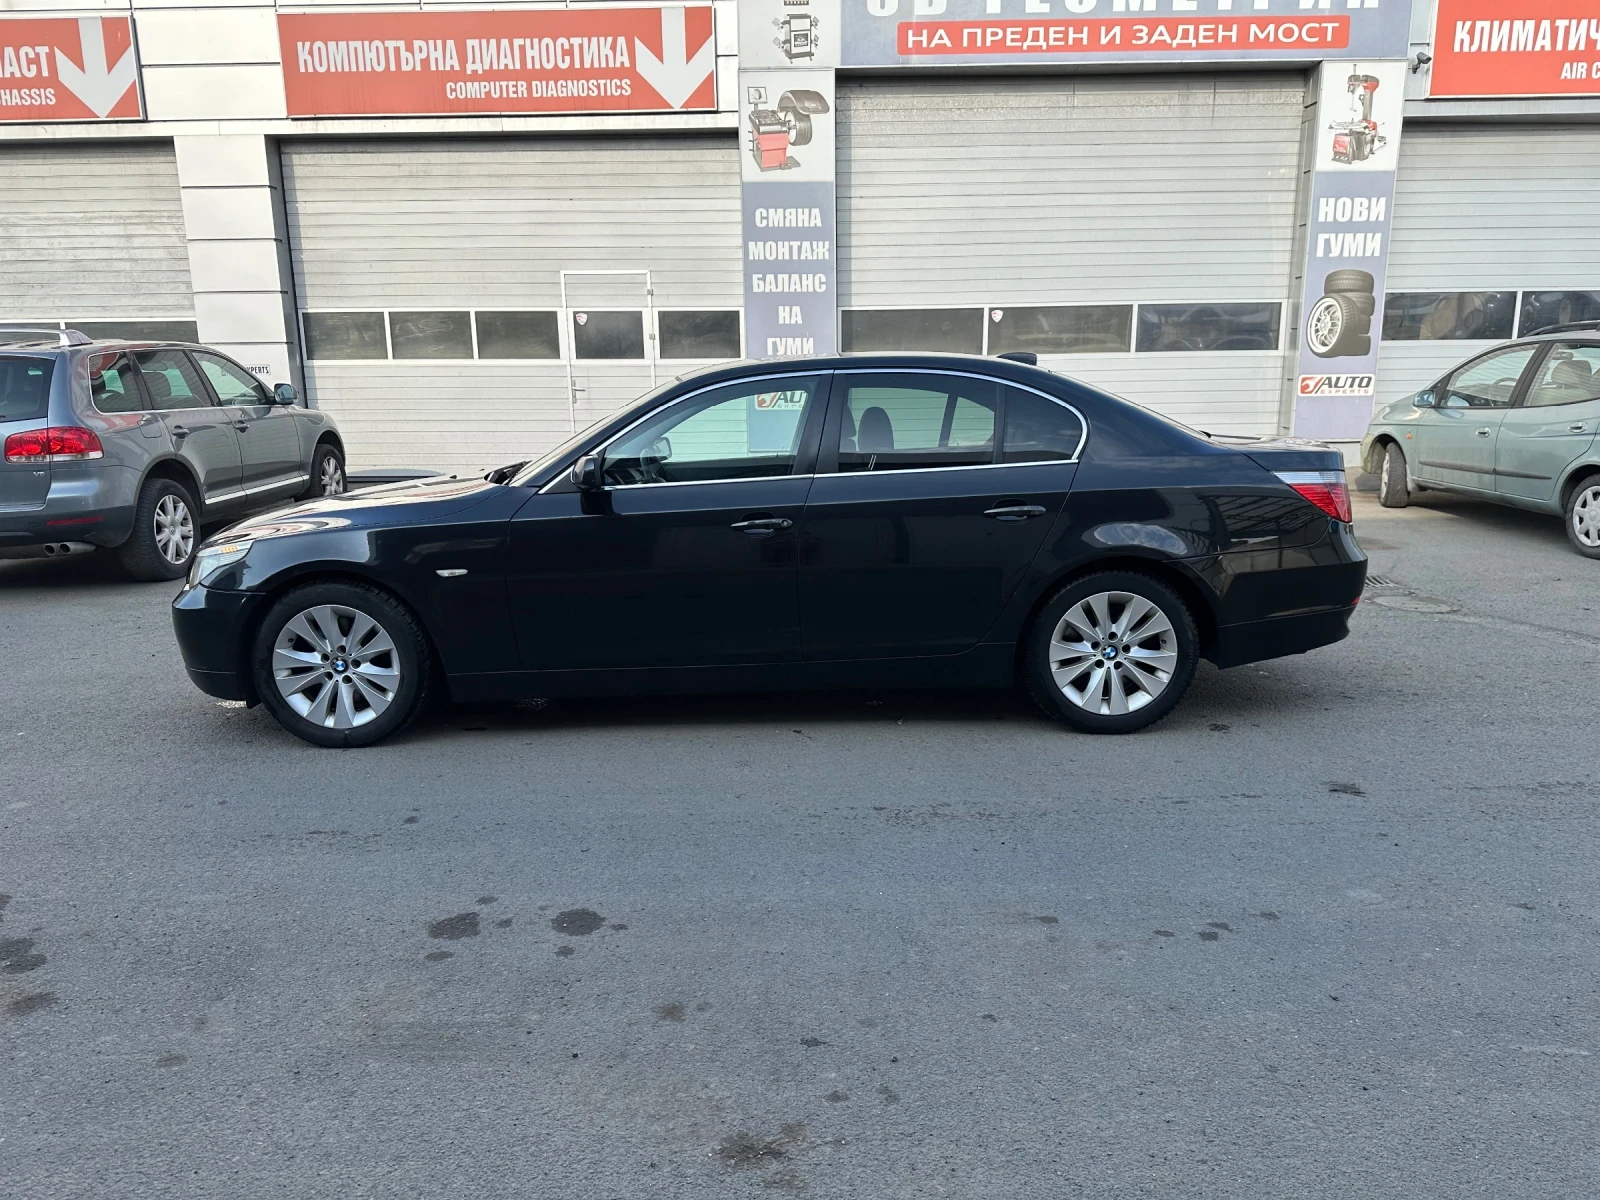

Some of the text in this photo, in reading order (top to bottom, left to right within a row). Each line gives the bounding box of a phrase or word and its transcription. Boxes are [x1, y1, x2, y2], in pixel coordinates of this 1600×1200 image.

[907, 22, 1340, 51] НА ПРЕДЕН И ЗАДЕН МОСТ
[1452, 19, 1600, 53] КЛИМАТИЧ
[0, 45, 49, 78] АСТ
[296, 36, 631, 75] КОМПЮТЪРНА ДИАГНОСТИКА
[1560, 62, 1588, 80] AIR
[0, 88, 56, 106] HASSIS
[445, 78, 632, 99] COMPUTER DIAGNOSTICS
[754, 207, 822, 228] СМЯНА
[1317, 196, 1387, 223] НОВИ
[748, 240, 830, 260] МОНТАЖ
[1315, 232, 1382, 258] ГУМИ
[752, 273, 827, 293] БАЛАНС
[778, 305, 803, 325] НА
[766, 337, 814, 356] ГУМИ
[1315, 376, 1373, 391] AUTO
